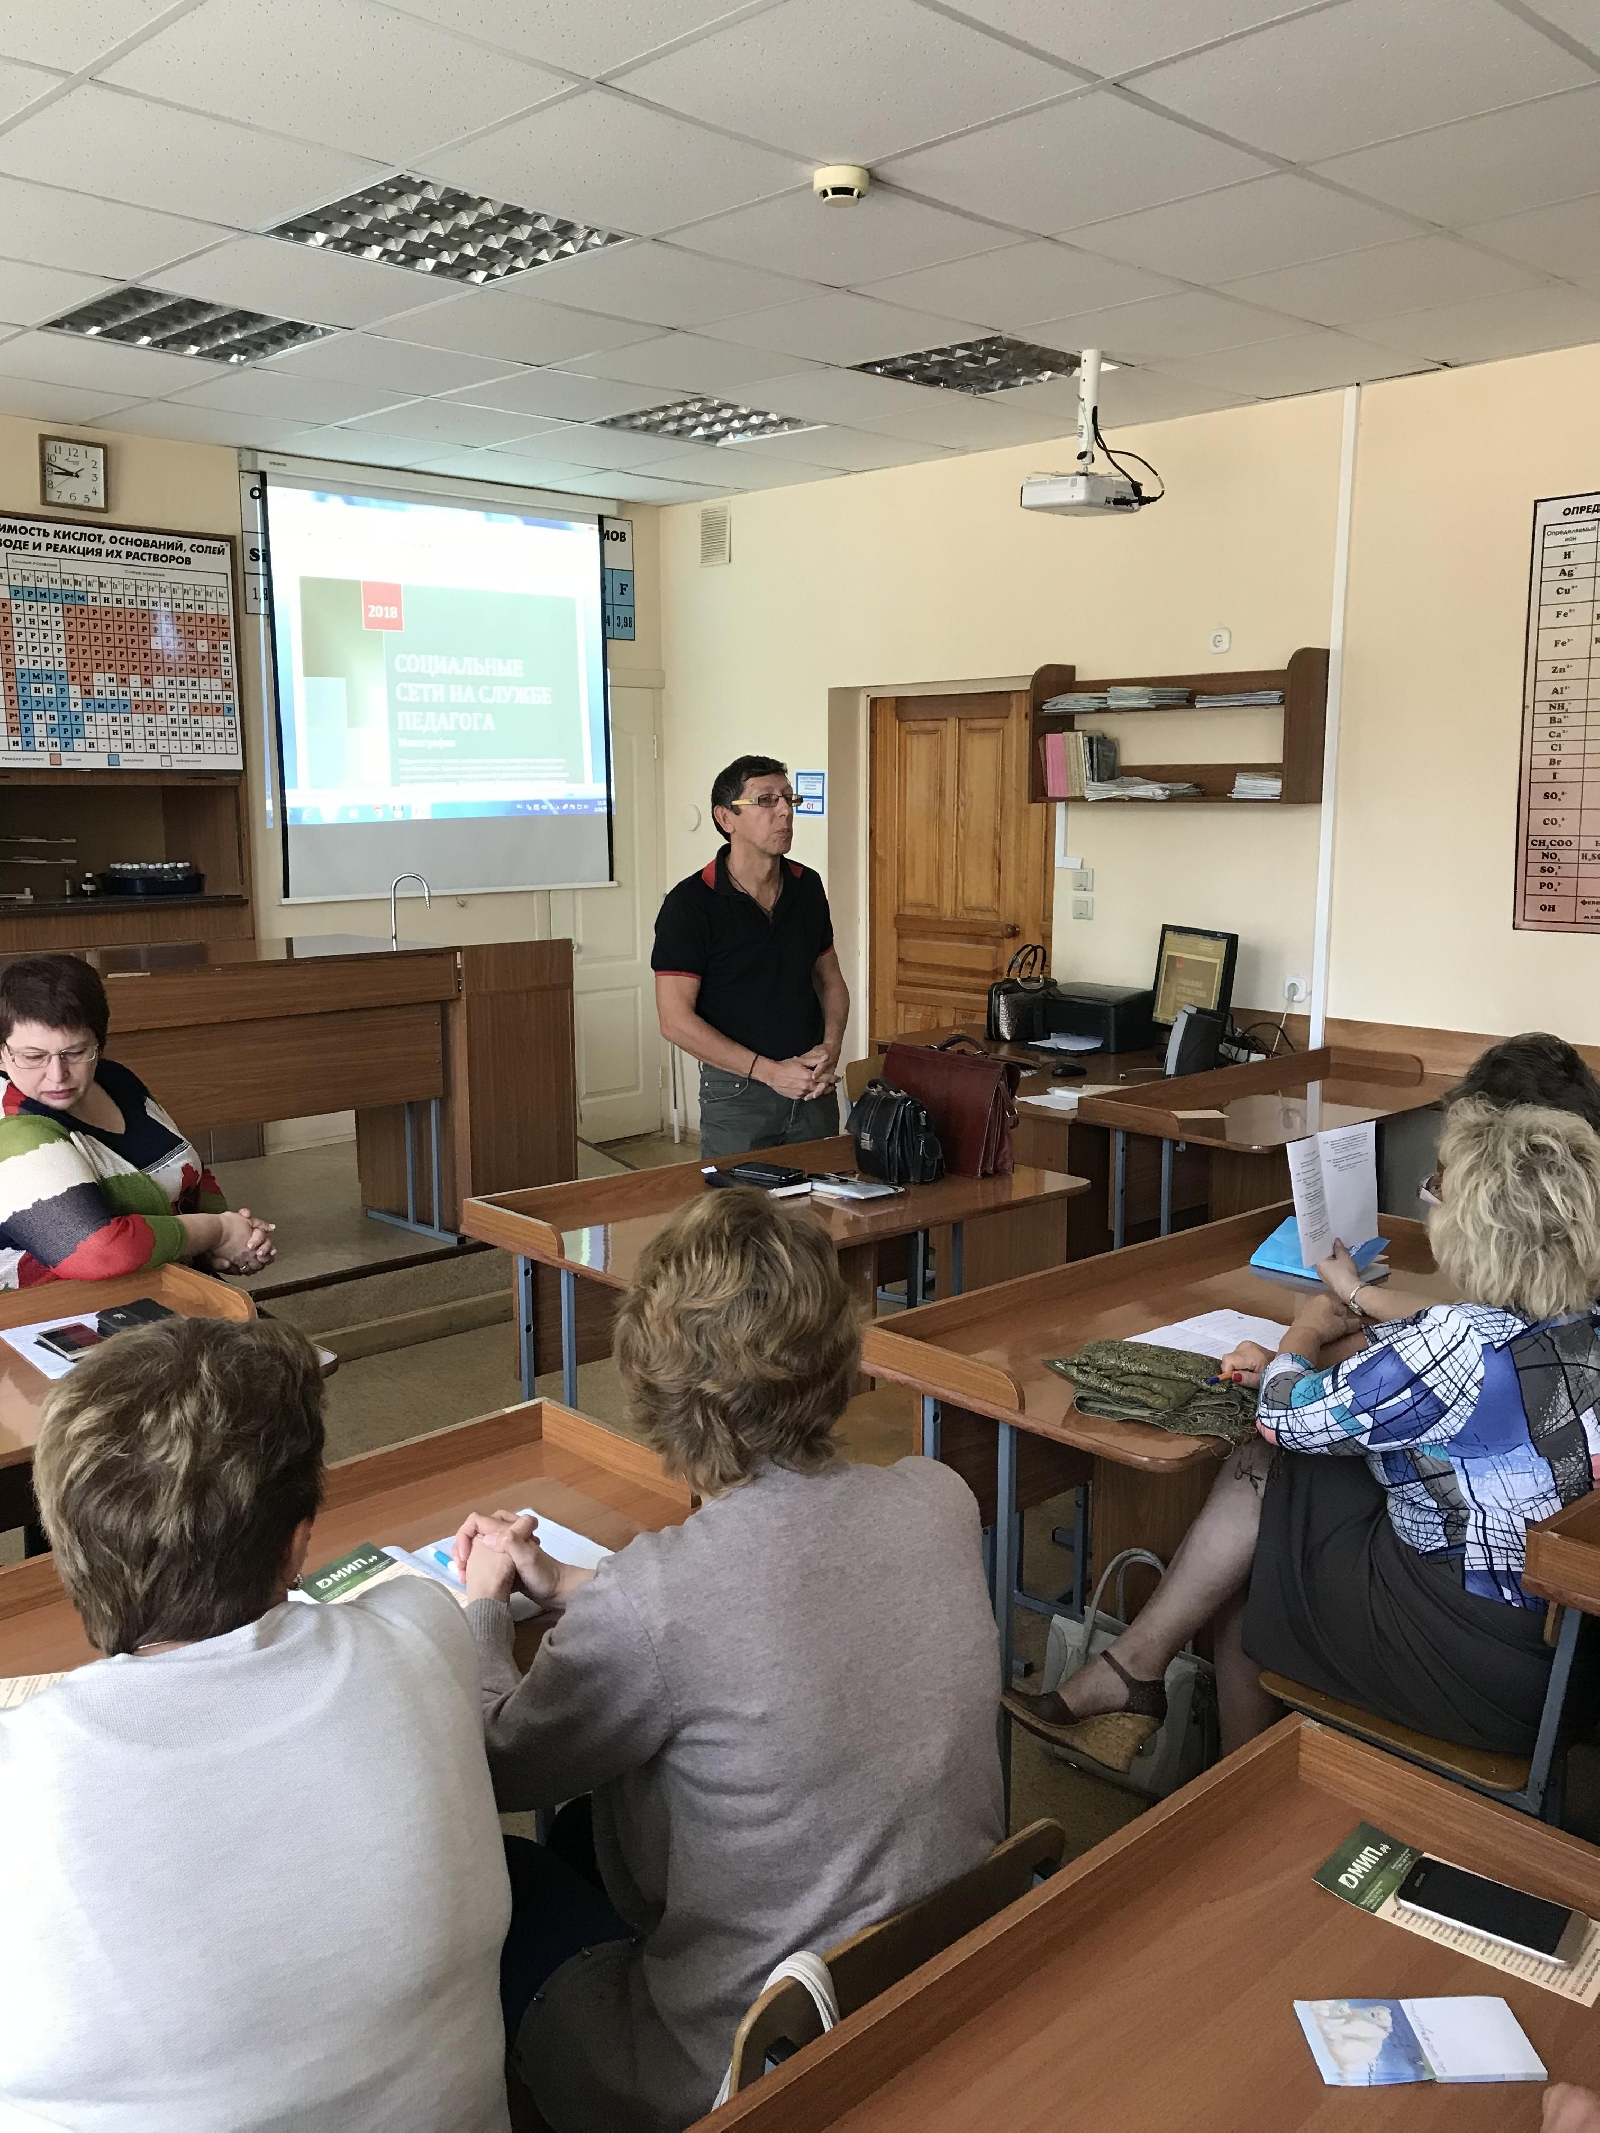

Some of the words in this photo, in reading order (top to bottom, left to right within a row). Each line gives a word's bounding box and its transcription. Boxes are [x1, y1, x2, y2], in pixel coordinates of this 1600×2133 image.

[55, 445, 61, 454] 11
[69, 448, 78, 457] 12
[84, 450, 88, 458] 1
[47, 453, 56, 462] 10
[91, 460, 97, 468] 2
[47, 467, 53, 475] 9
[92, 474, 98, 482] 3
[47, 480, 53, 489] 8
[57, 491, 62, 499] 7
[92, 487, 98, 495] 4
[70, 493, 76, 501] 6
[84, 495, 90, 503] 5
[1562, 504, 1600, 516] ОПРЕД
[0, 524, 50, 538] ИМОСТЬ
[53, 530, 106, 545] КИСЛОТ,
[109, 536, 186, 553] ОСНОВАНИЙ,
[190, 544, 226, 555] СОЛЕЙ
[0, 538, 29, 550] ОДЕ
[32, 542, 42, 551] И
[45, 543, 102, 557] РЕАКЦИЯ
[106, 549, 122, 559] ИХ
[126, 551, 192, 565] РАСТВОРОВ
[620, 583, 628, 595] F
[368, 604, 398, 619] 2018
[394, 654, 524, 678] СОЦИАЛЬНЫЕ
[395, 683, 446, 703] СЕТИ
[451, 685, 477, 703] НА
[478, 685, 553, 705] СЛУЖБЕ
[397, 711, 496, 733] ПЕДАГОГА
